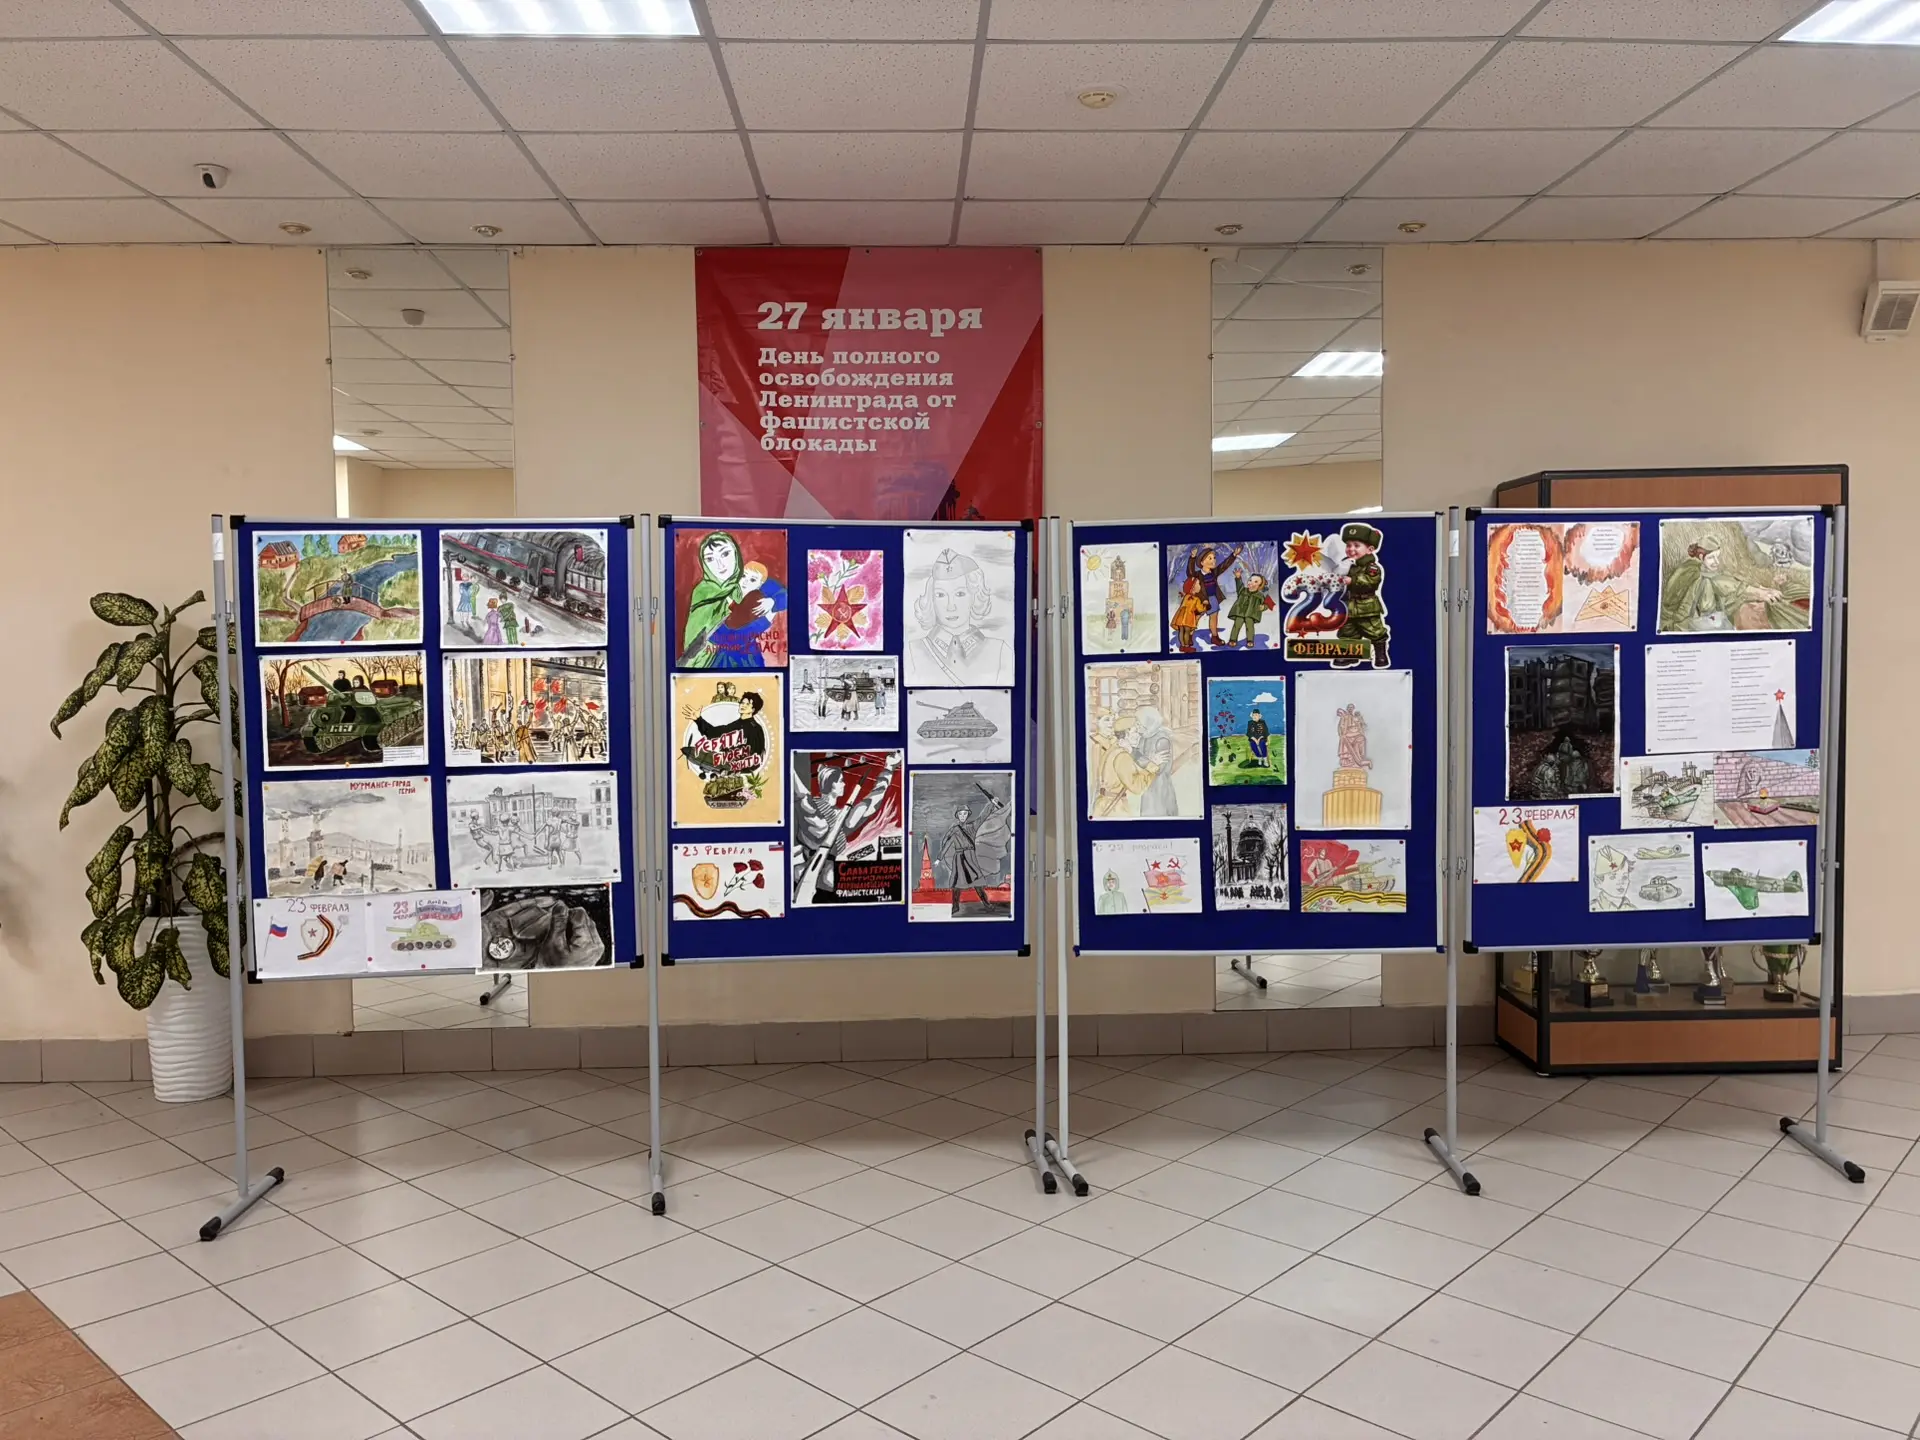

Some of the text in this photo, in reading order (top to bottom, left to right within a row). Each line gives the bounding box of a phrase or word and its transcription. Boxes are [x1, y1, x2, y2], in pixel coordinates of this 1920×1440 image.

[757, 302, 983, 337] 27 января
[758, 347, 940, 367] День полного
[759, 368, 954, 388] освобождения
[759, 390, 957, 412] Ленинграда от
[759, 411, 930, 434] фашистской
[760, 433, 877, 454] блокады
[1283, 572, 1348, 633] 23
[1293, 642, 1364, 656] ФЕВРАЛЯ
[1499, 807, 1576, 825] 23 ФЕВРАЛЯ
[682, 846, 699, 857] 23
[286, 897, 350, 913] 23 ФЕВРАЛЯ
[392, 900, 409, 915] 23
